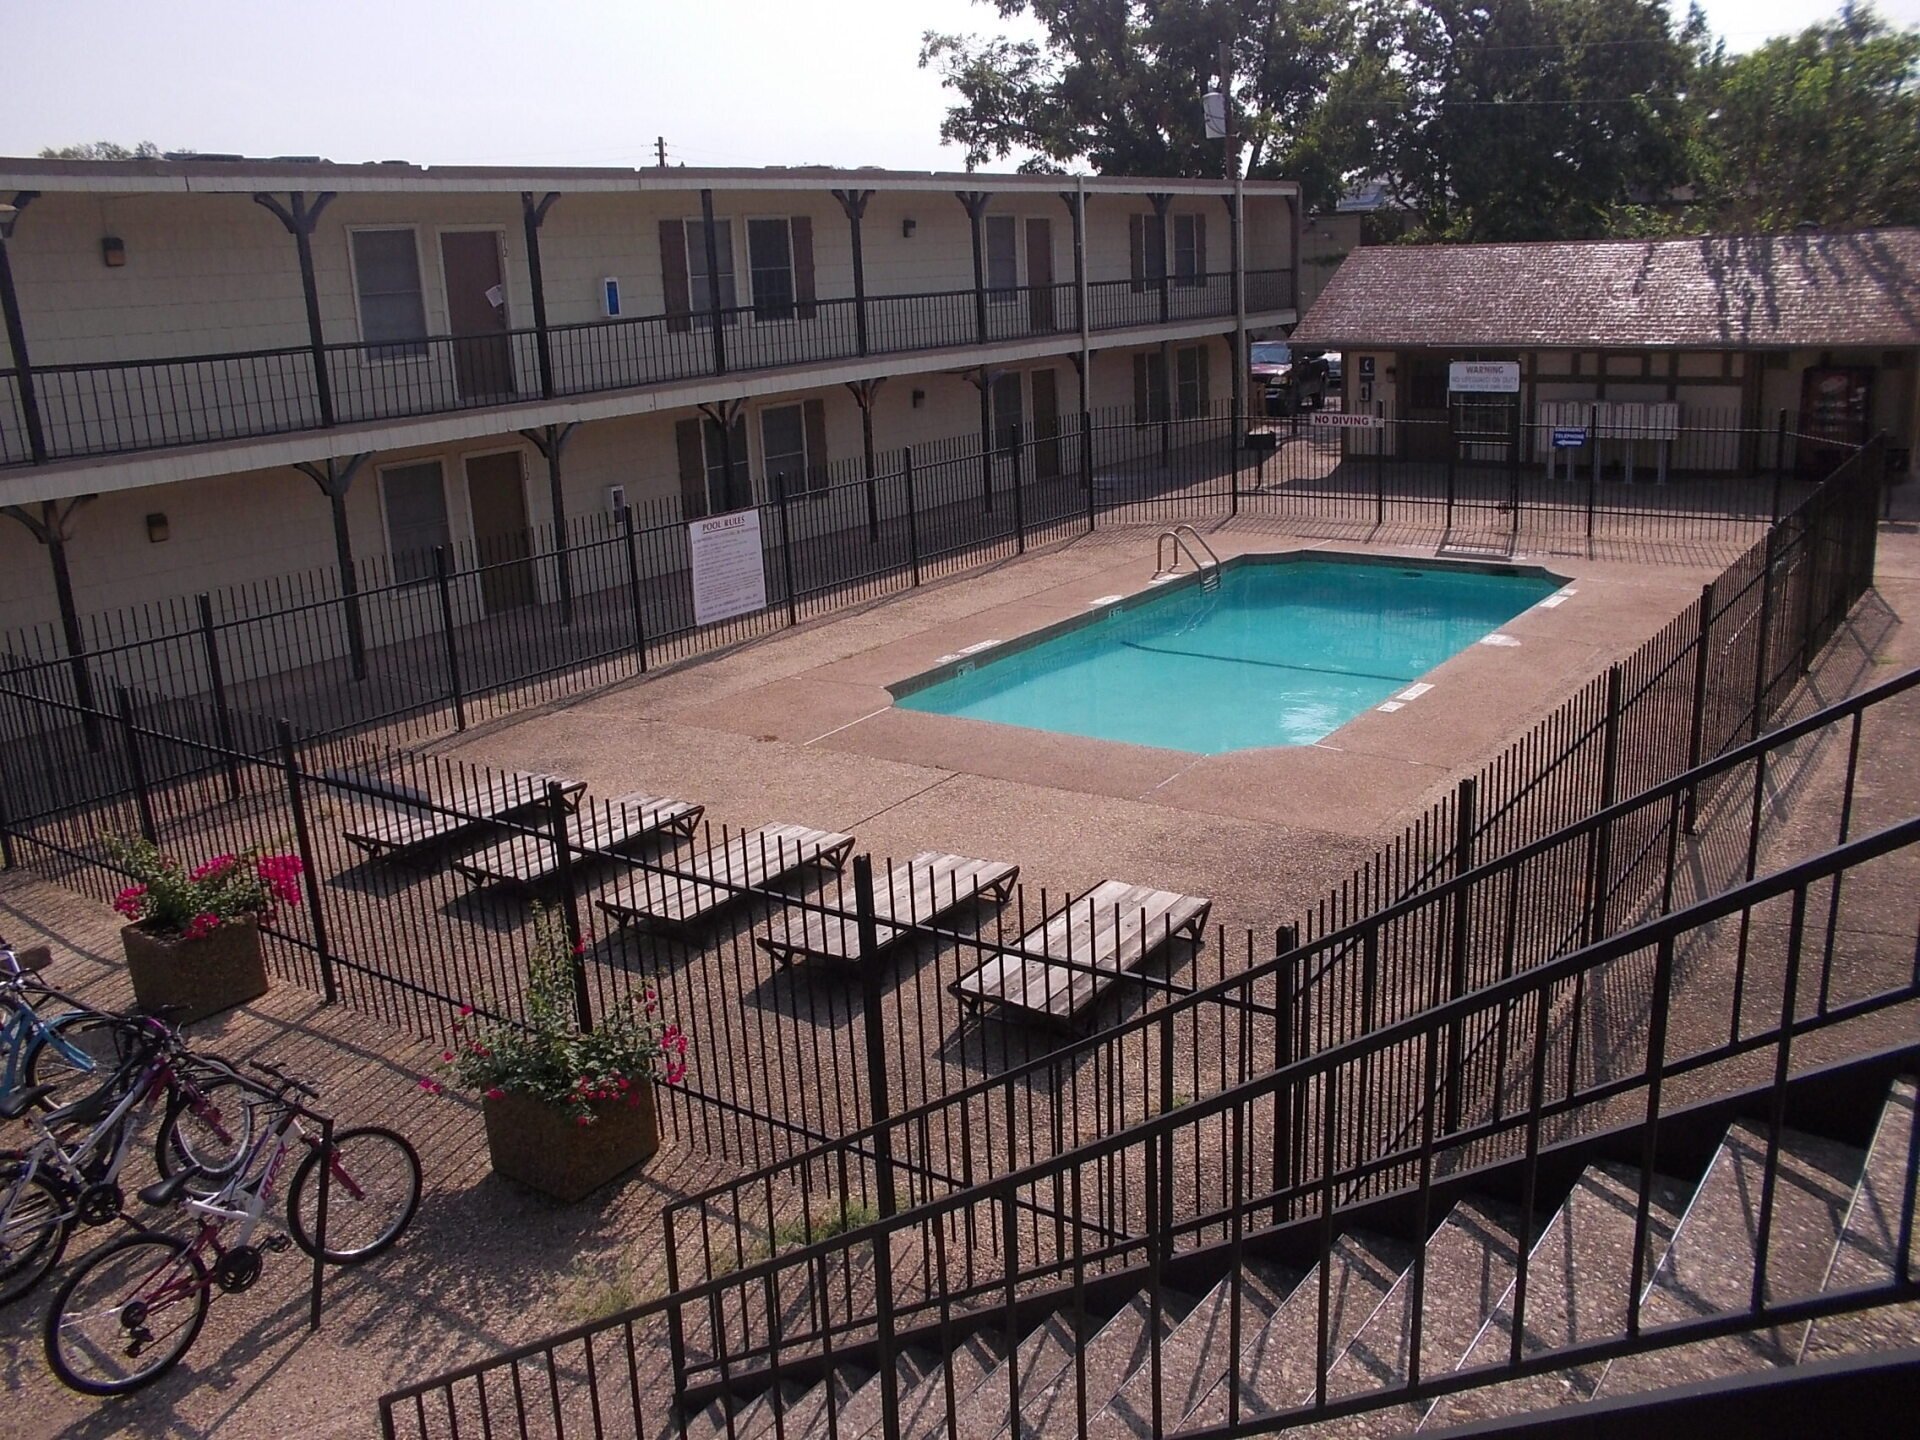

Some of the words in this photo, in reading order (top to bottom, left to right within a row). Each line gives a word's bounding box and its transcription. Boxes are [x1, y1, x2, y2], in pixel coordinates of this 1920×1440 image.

[1466, 366, 1504, 374] WARNING
[1314, 415, 1329, 424] NO
[1332, 416, 1369, 425] DIVING
[702, 520, 722, 532] POOL
[724, 515, 745, 527] RULES
